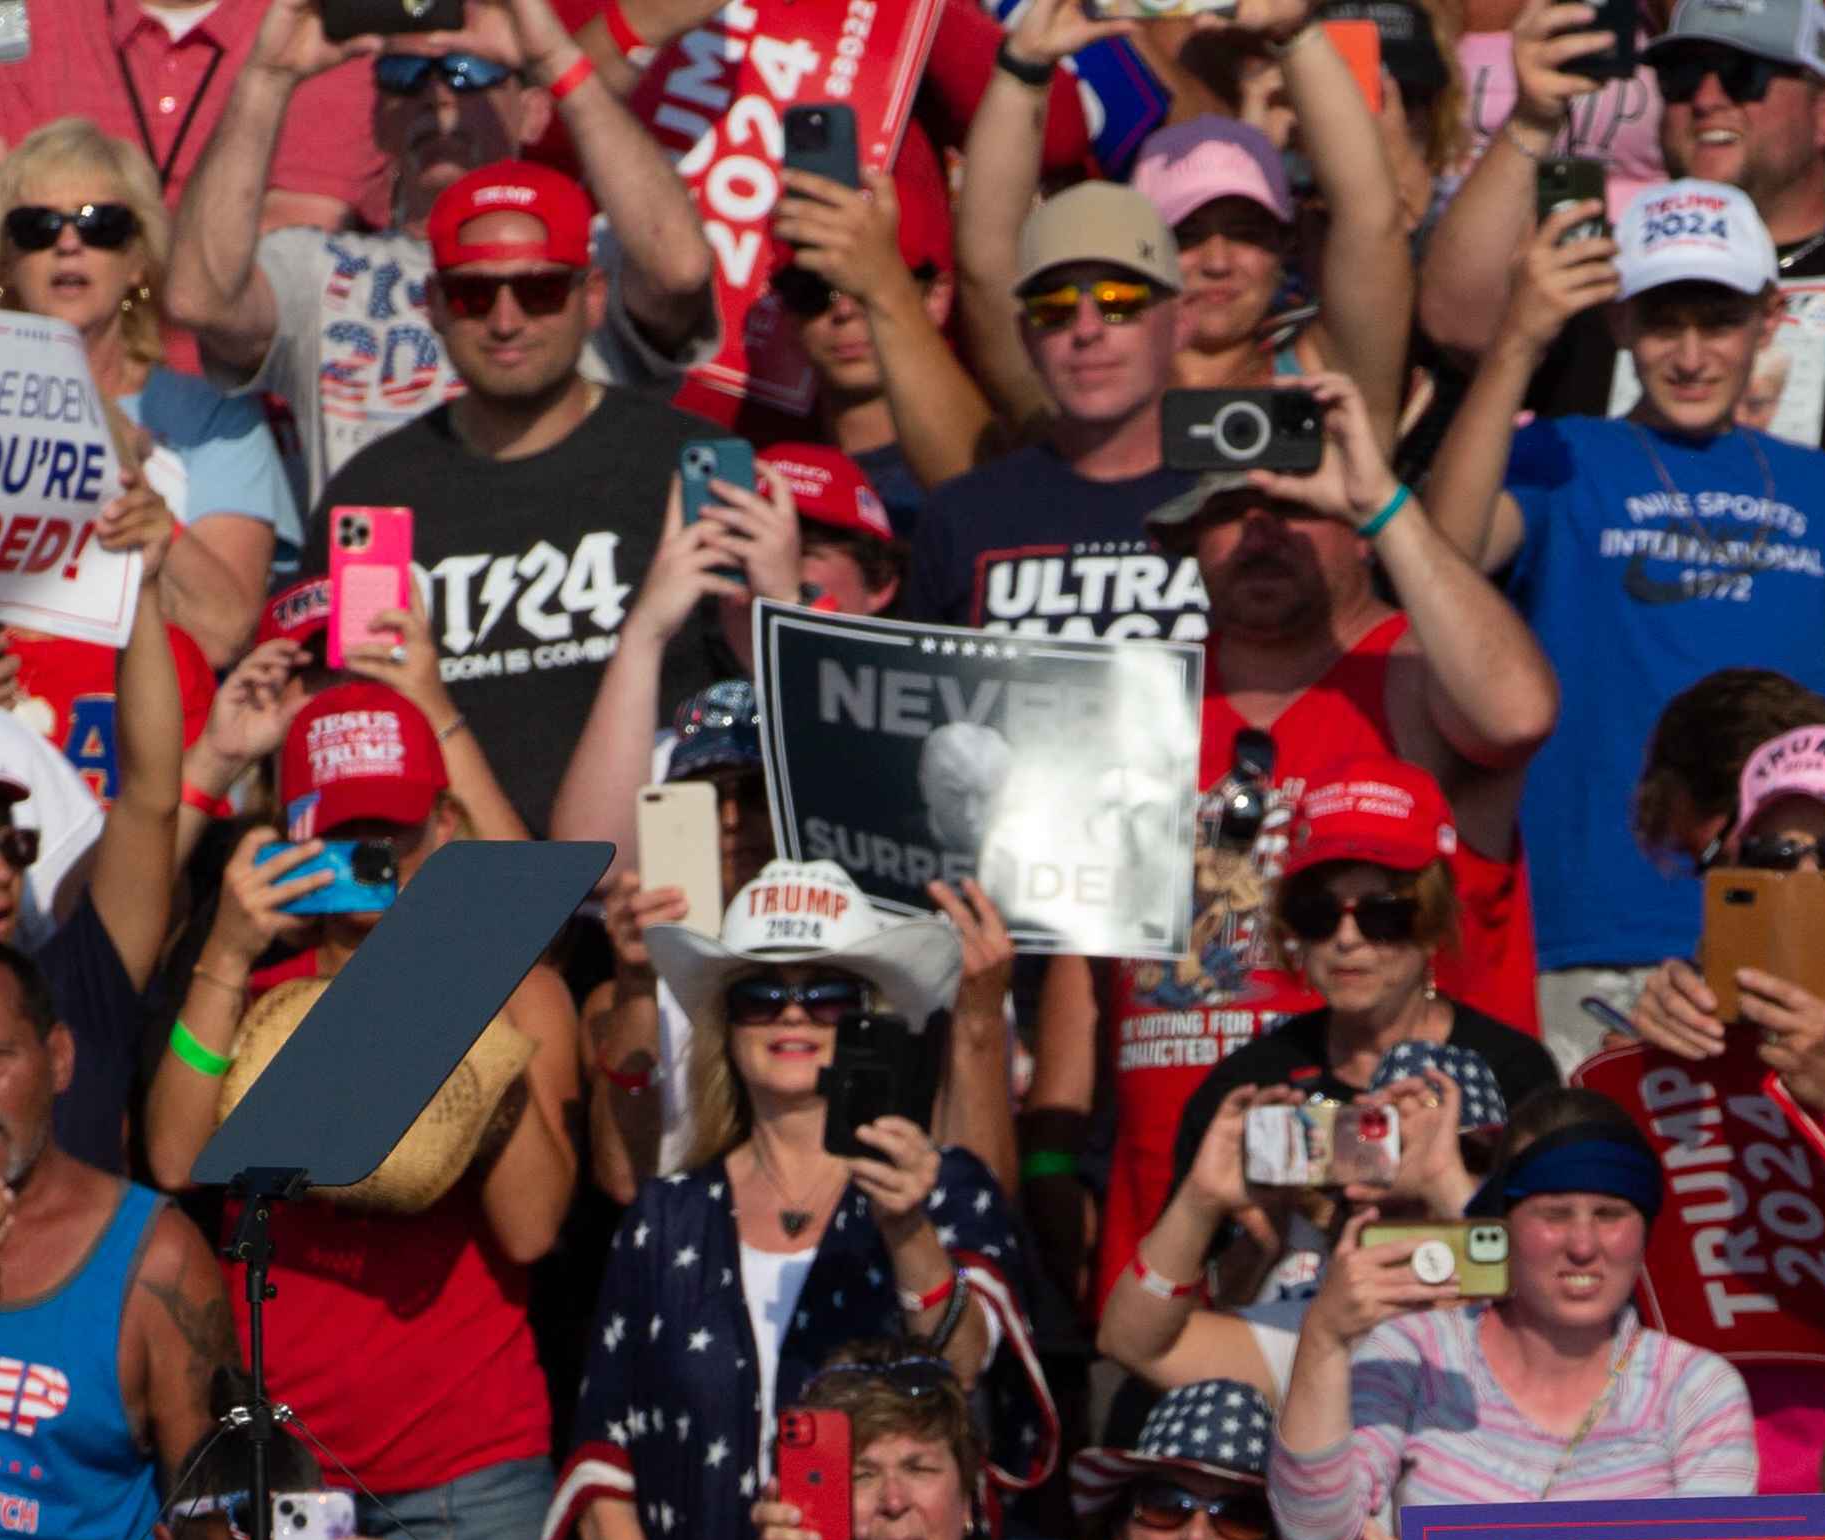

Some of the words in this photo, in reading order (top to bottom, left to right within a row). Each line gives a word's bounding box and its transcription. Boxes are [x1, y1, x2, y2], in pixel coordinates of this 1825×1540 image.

[705, 30, 820, 286] 2024
[1644, 214, 1728, 243] 2024
[13, 373, 100, 426] BIDEN
[1628, 494, 1691, 523] NIKE
[1697, 492, 1807, 537] SPORTS
[988, 556, 1210, 618] ULTRA
[311, 742, 405, 771] TRUMP
[749, 883, 850, 920] TRUMP
[1638, 1067, 1779, 1328] TRUMP
